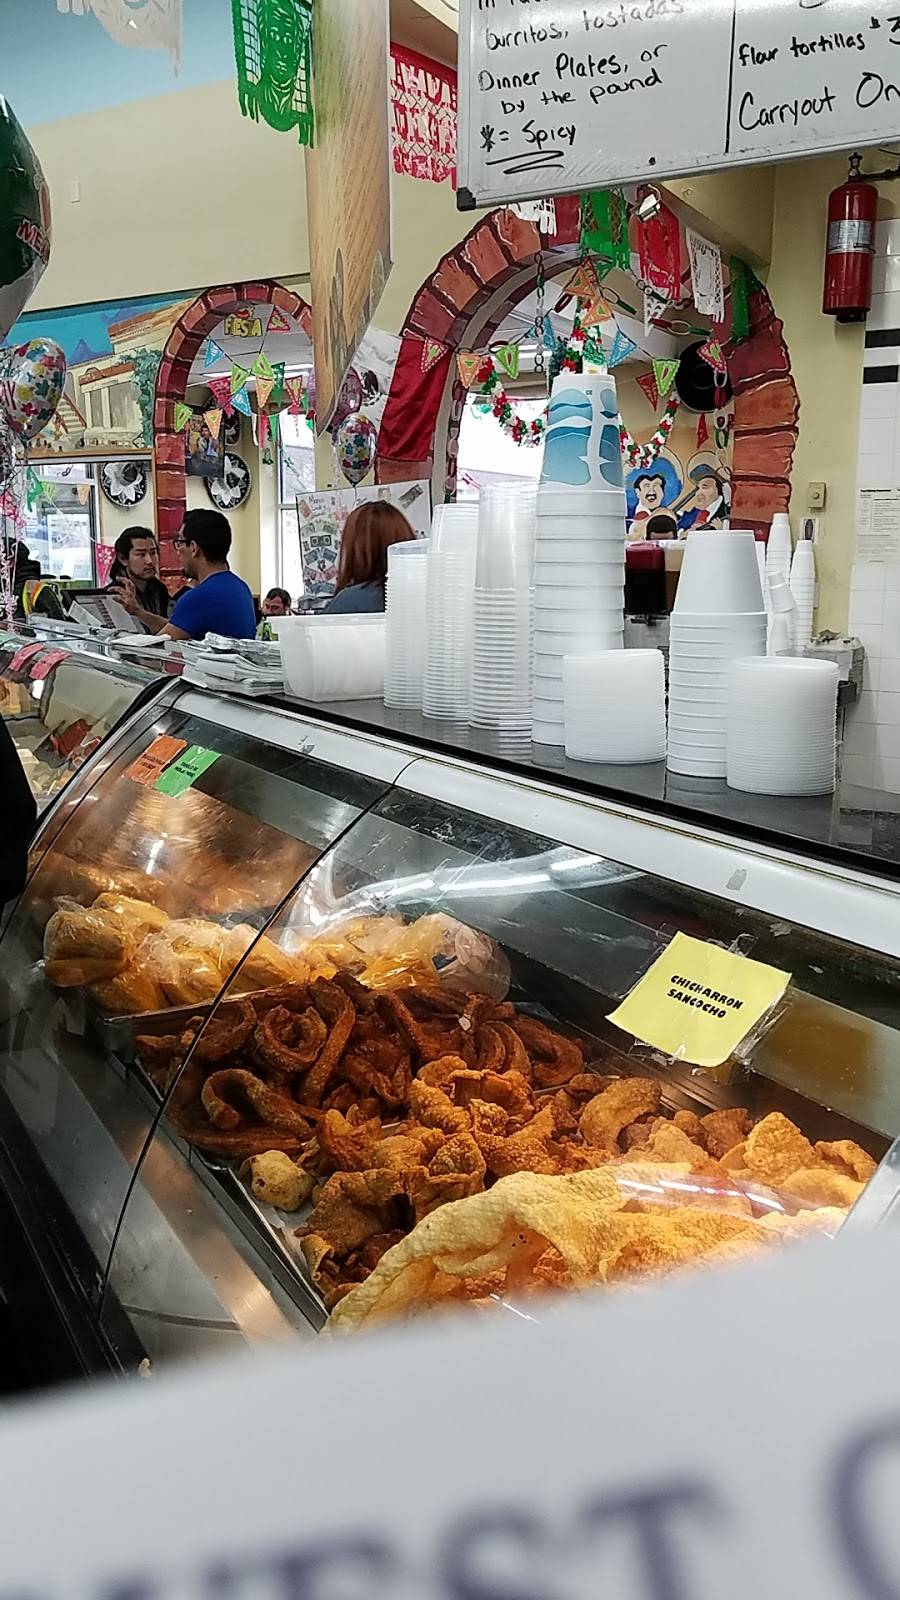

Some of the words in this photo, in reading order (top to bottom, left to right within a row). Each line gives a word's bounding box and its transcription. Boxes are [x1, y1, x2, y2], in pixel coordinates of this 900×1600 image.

[738, 43, 779, 66] flour
[789, 33, 866, 58] tortillas
[478, 69, 540, 91] Dinner
[555, 52, 629, 80] Plates,
[640, 44, 668, 62] or
[501, 100, 525, 115] by
[540, 91, 577, 105] the
[589, 67, 663, 104] pound
[738, 86, 836, 131] Carryout
[521, 120, 577, 149] Spicy
[224, 316, 262, 338] FIESTA
[667, 988, 727, 1019] SANCOCHO
[670, 974, 743, 1010] CHICHARRON
